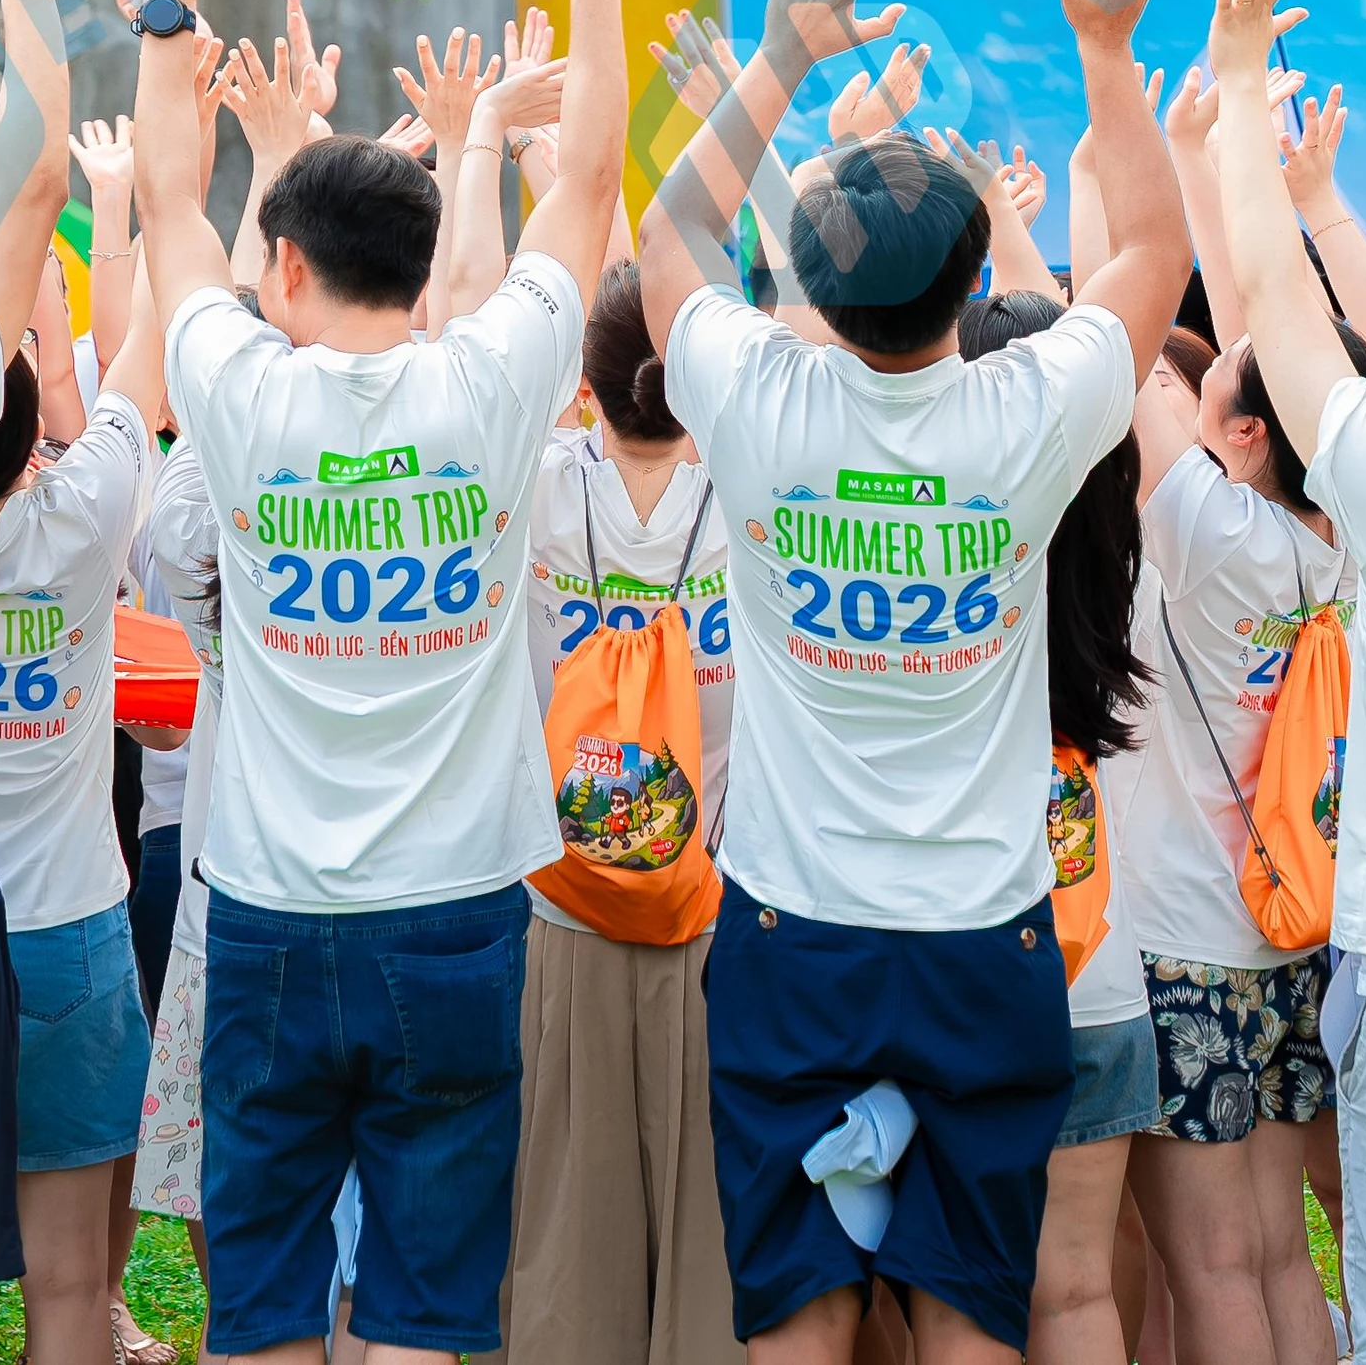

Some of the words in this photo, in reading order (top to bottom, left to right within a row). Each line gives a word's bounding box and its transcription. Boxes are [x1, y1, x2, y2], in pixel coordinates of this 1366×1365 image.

[329, 460, 380, 474] MASAN
[848, 479, 905, 493] MASAN
[257, 492, 401, 552] SUMMER
[411, 484, 488, 547] TRIP
[773, 507, 927, 577] SUMMER
[935, 517, 1012, 576] TRIP
[267, 546, 481, 623] 2026
[786, 569, 999, 643] 2026
[2, 607, 64, 655] TRIP
[261, 625, 299, 654] VỮNG
[304, 634, 332, 661] NỘI
[336, 635, 364, 660] LỰC
[380, 629, 409, 657] BỀN
[414, 625, 464, 654] TƯƠNG
[467, 617, 489, 647] LAI
[786, 635, 823, 666] VỮNG
[828, 649, 854, 671] NỘI
[859, 651, 887, 675] LỰC
[903, 650, 932, 674] BỀN
[937, 647, 982, 673] TƯƠNG
[984, 636, 1004, 661] LAI
[46, 717, 66, 738] LAI
[574, 752, 618, 776] 2026
